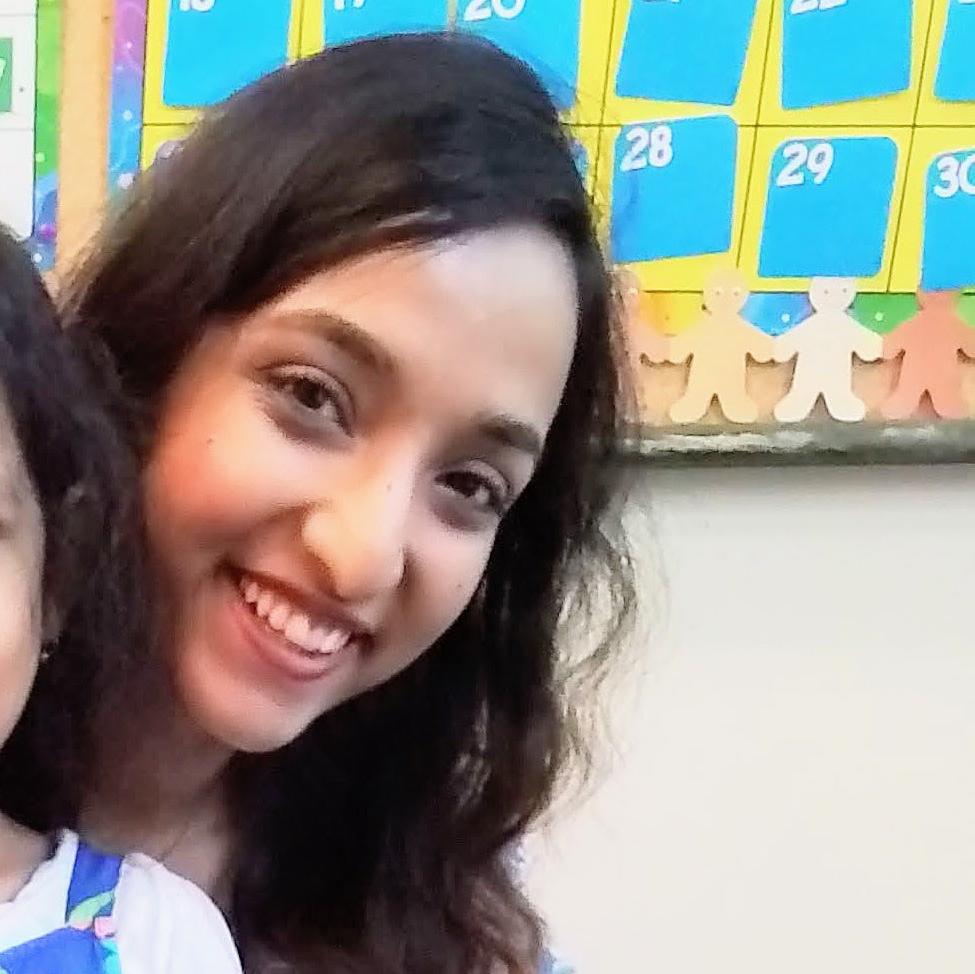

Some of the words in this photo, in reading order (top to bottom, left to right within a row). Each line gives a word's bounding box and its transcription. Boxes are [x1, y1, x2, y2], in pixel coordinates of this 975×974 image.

[620, 125, 673, 172] 28
[775, 143, 834, 187] 29
[933, 155, 975, 198] 30
